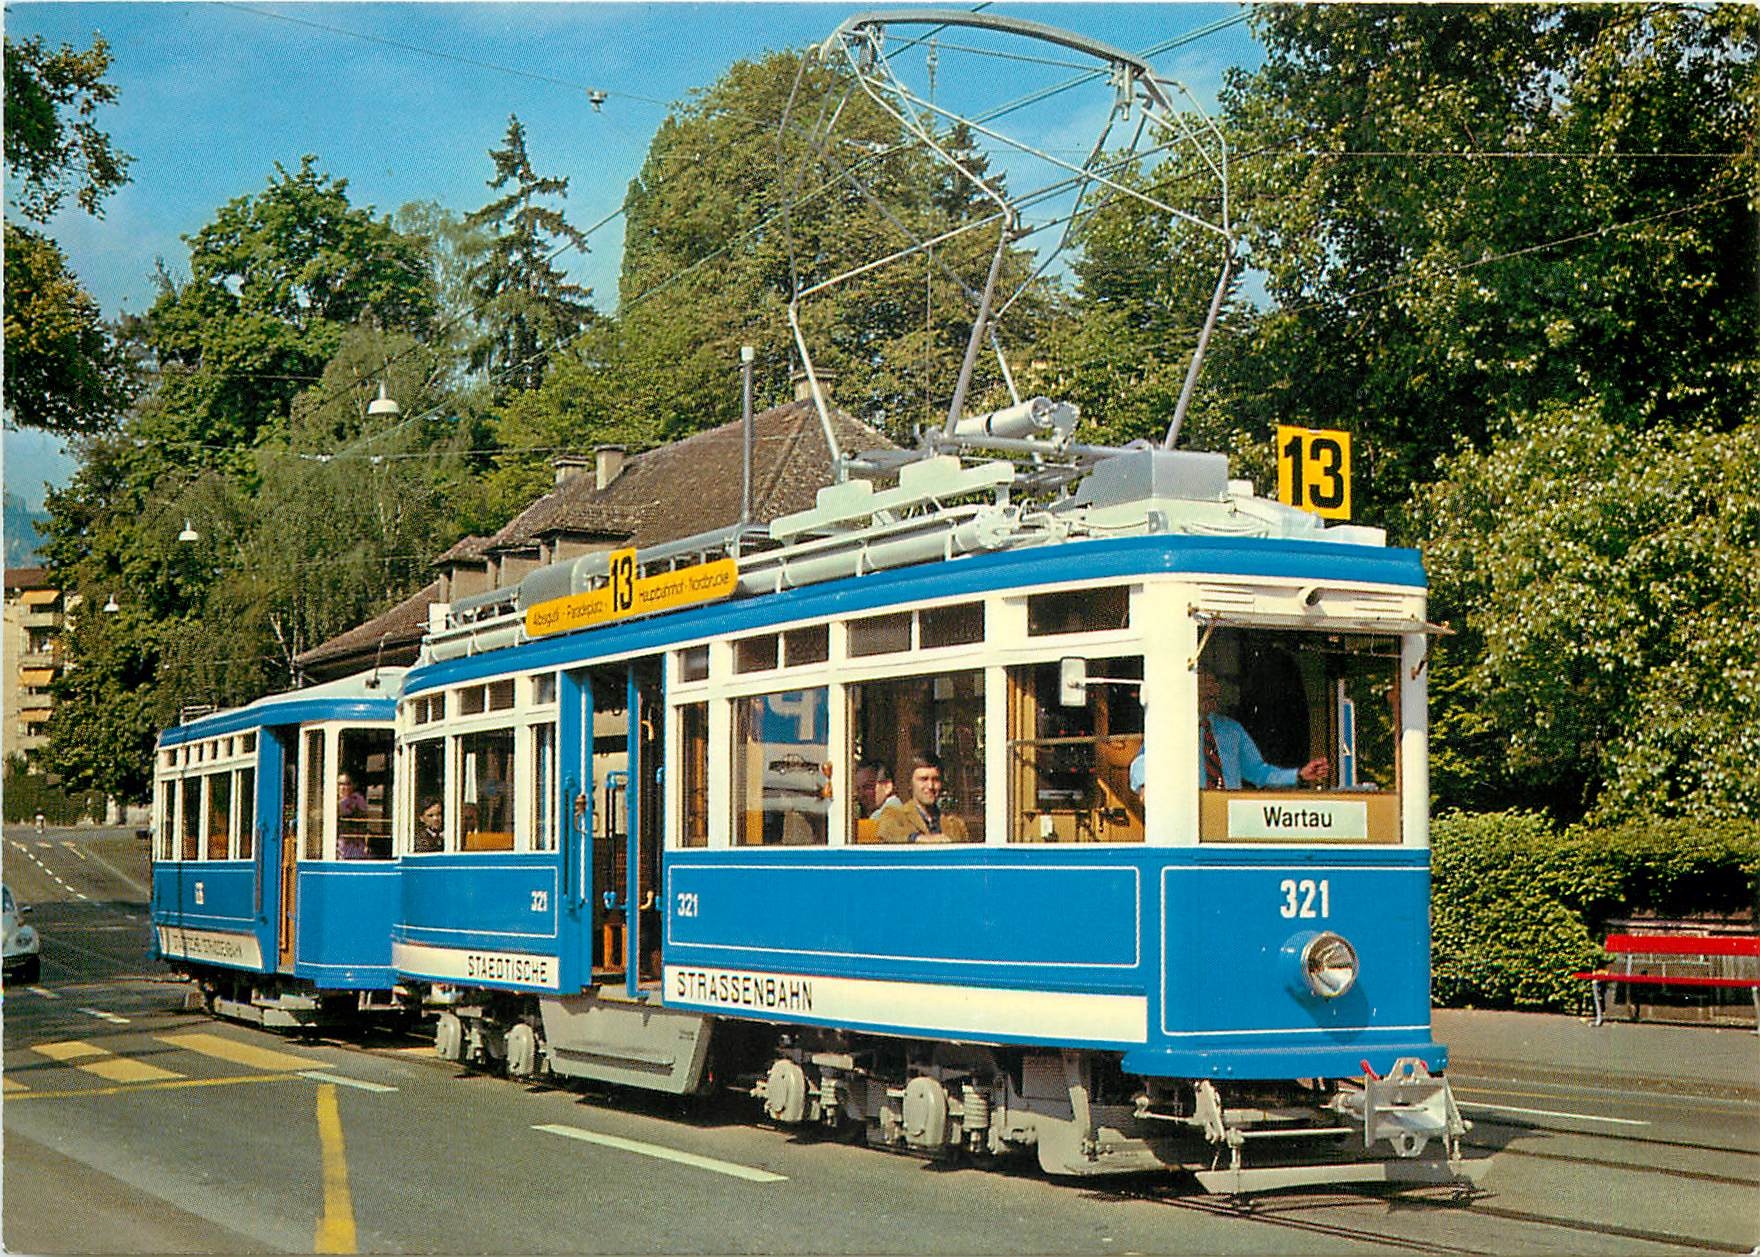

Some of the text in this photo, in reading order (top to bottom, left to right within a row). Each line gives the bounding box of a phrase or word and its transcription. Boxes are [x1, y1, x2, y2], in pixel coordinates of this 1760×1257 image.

[1284, 436, 1344, 509] 13
[610, 556, 633, 612] 13
[1263, 806, 1333, 828] Wartau
[530, 890, 548, 912] 321
[677, 893, 698, 917] 321
[1280, 879, 1330, 919] 321
[467, 955, 548, 983] STAEDTISCHE
[677, 971, 813, 1011] STRASSENBAHN
